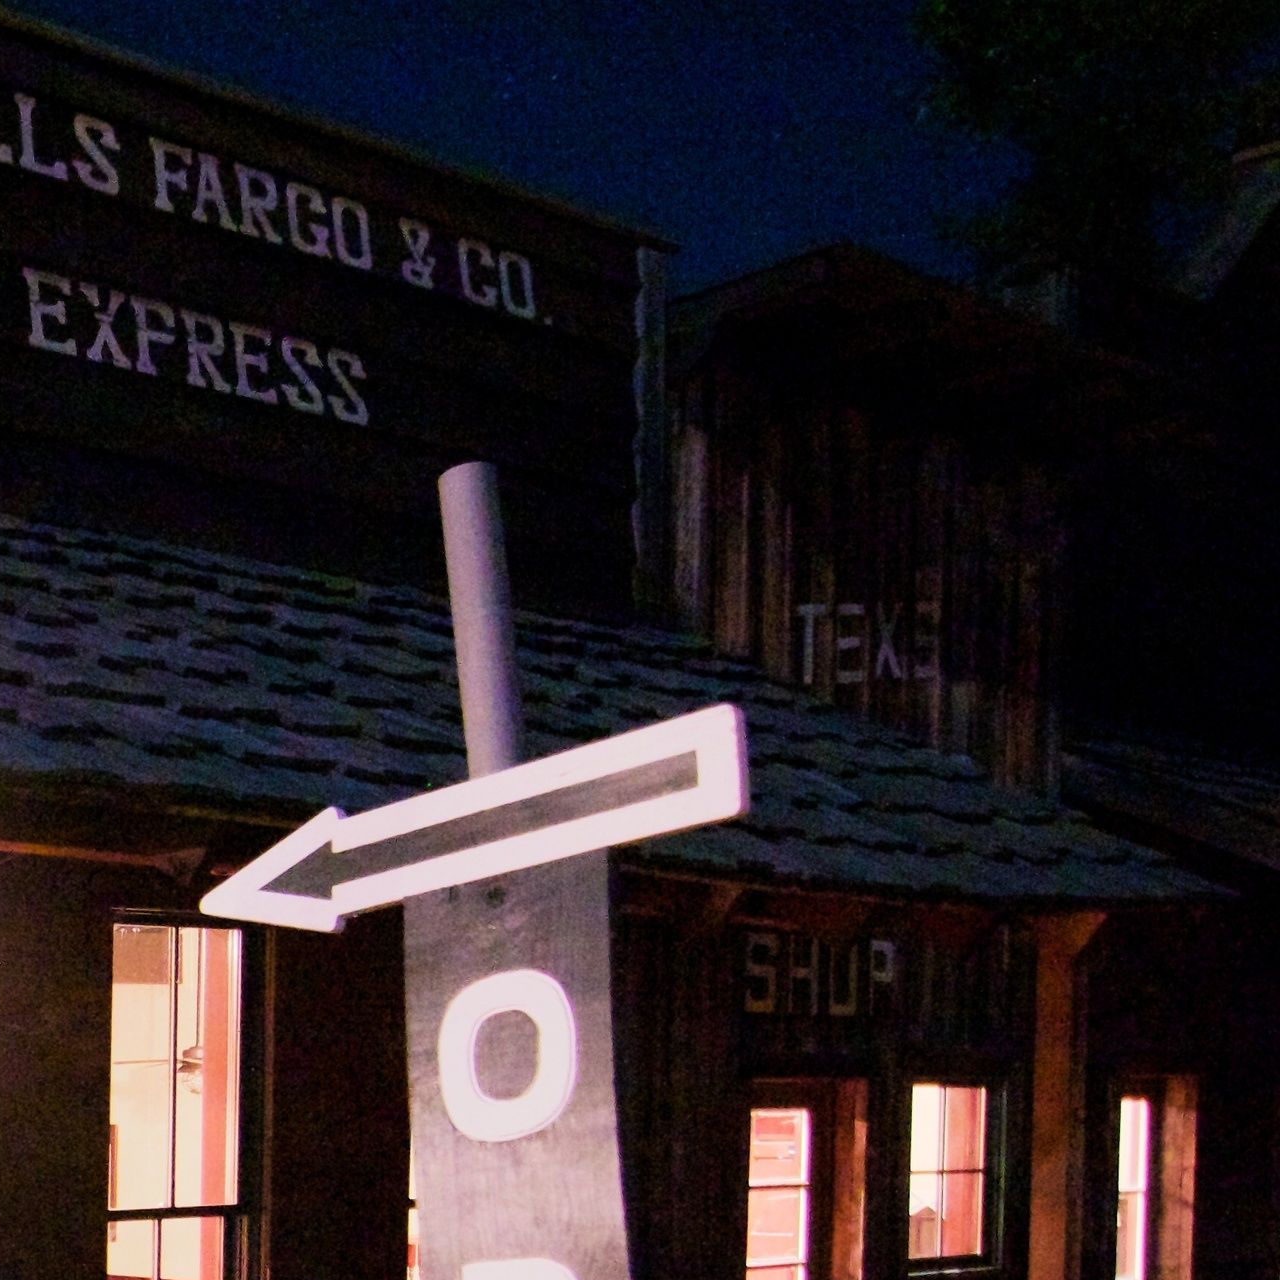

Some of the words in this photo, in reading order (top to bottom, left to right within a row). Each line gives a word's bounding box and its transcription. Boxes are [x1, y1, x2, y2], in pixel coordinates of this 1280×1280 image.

[150, 137, 372, 269] FARGO
[400, 217, 437, 290] &
[458, 238, 553, 326] CO.
[22, 265, 370, 428] EXPRESS
